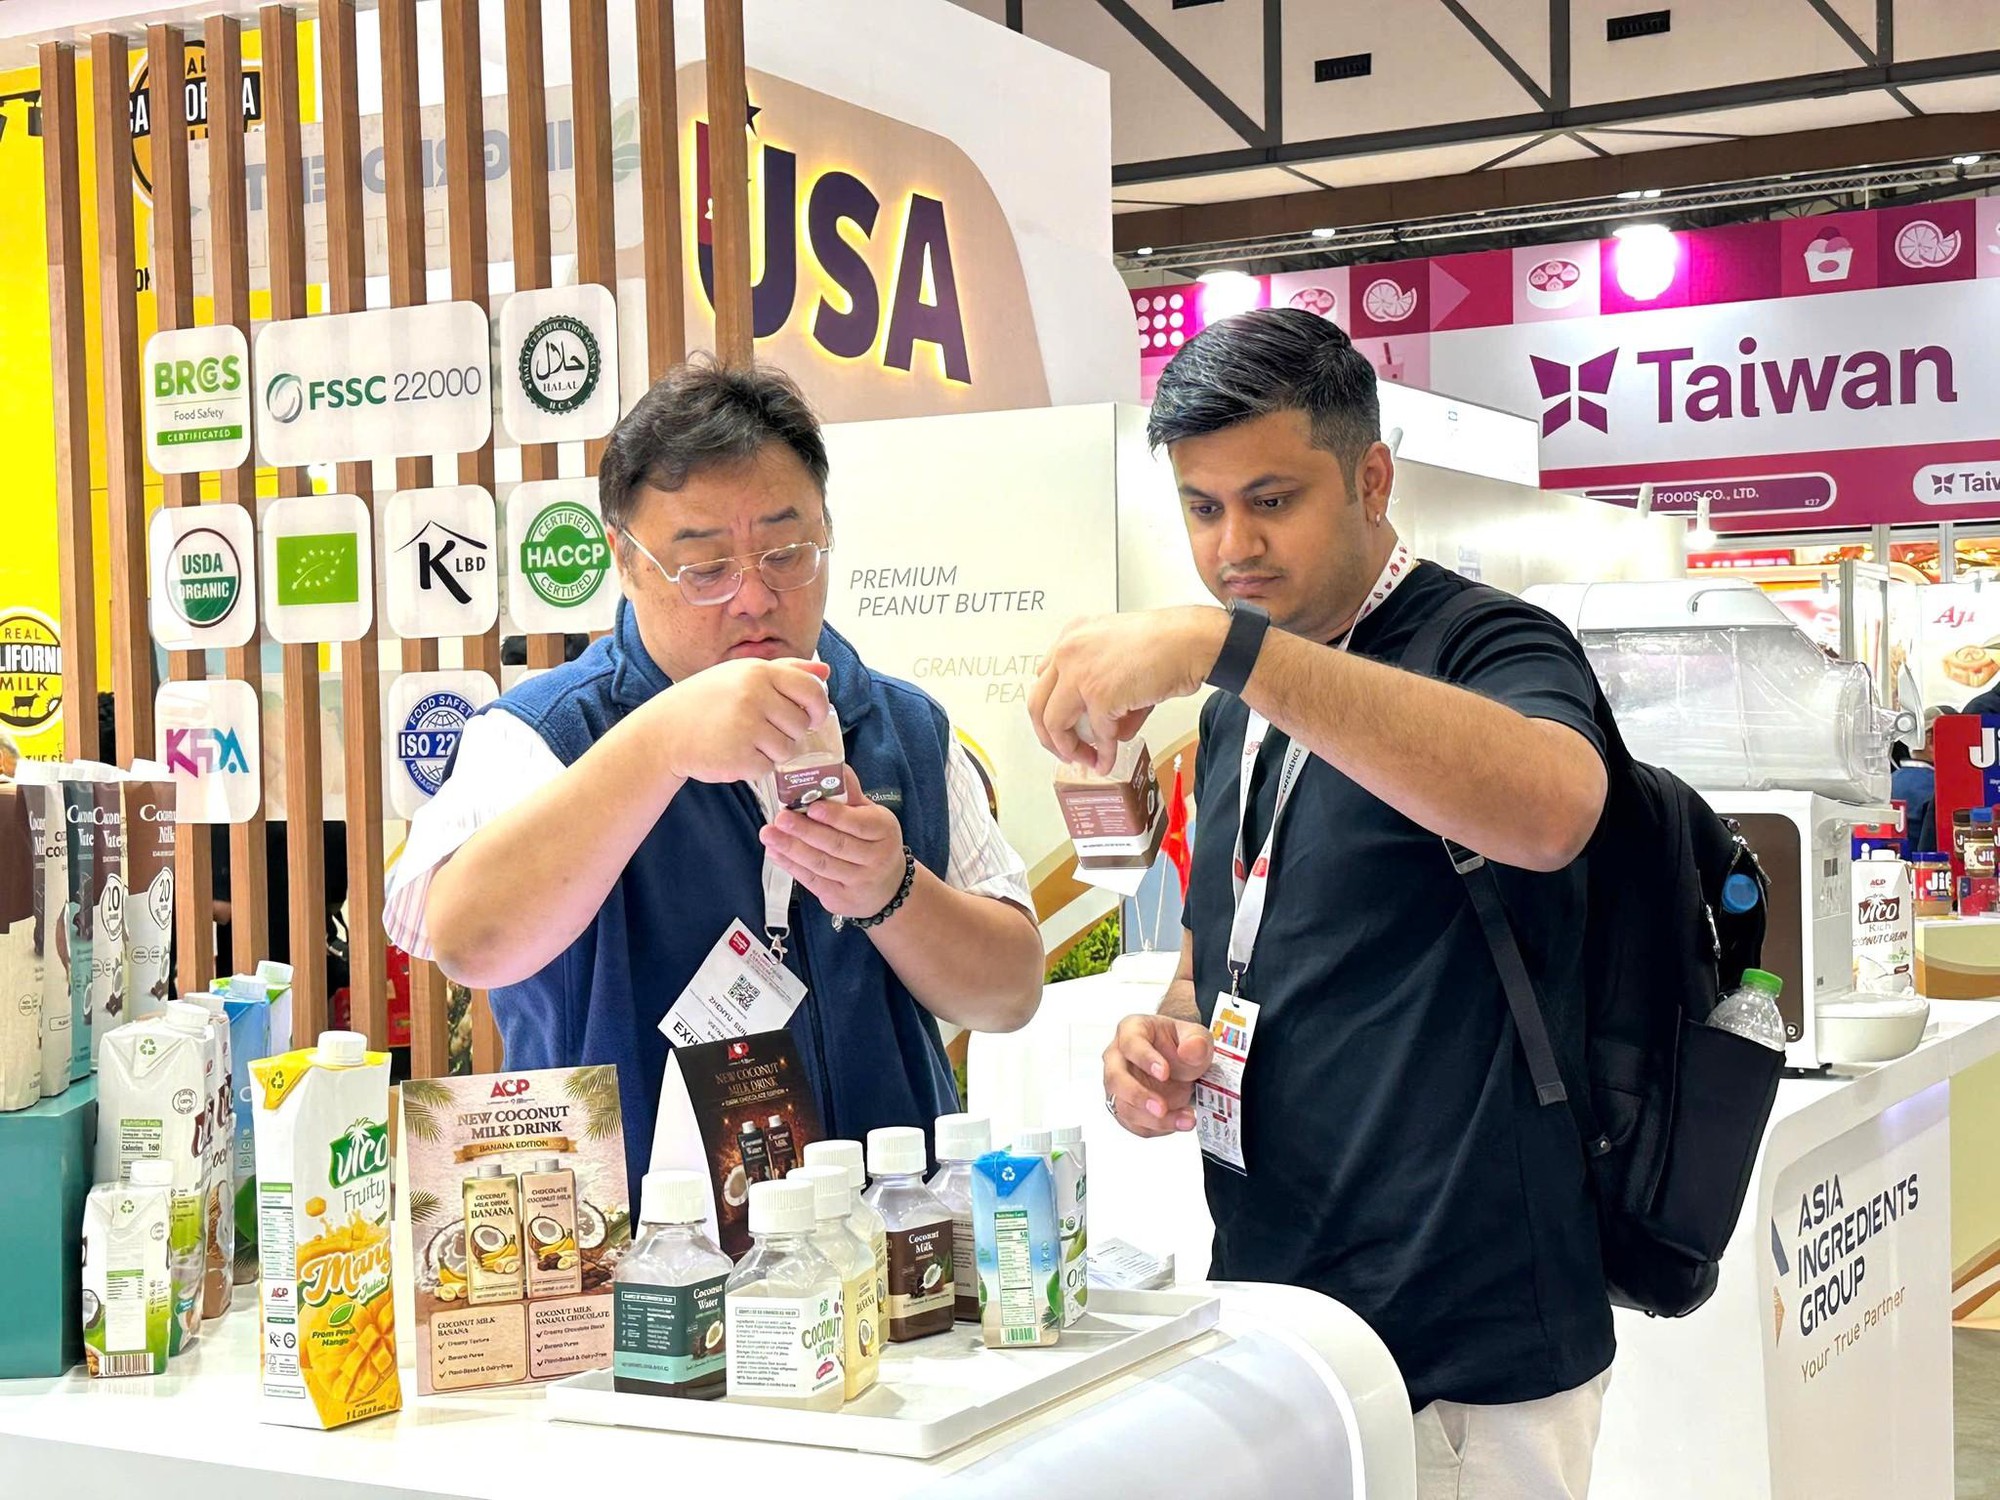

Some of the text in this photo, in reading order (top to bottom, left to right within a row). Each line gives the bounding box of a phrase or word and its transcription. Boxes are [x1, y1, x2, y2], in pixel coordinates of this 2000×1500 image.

[695, 121, 972, 385] USA
[309, 366, 481, 410] FSSC 22000
[543, 381, 579, 392] HALAL
[1637, 336, 1957, 423] Taiwan
[174, 407, 224, 421] Food Safety
[167, 428, 231, 443] CERTIFICATED
[1657, 492, 1700, 504] FOODS
[1734, 488, 1759, 499] LTD.
[539, 512, 591, 538] CERTIFIED
[181, 553, 224, 574] USDA
[455, 556, 486, 573] LBD
[526, 543, 605, 569] HACCP
[540, 573, 592, 597] CERTIFIED
[850, 565, 957, 589] PREMIUM
[177, 582, 230, 600] ORGANIC
[858, 590, 1045, 617] PEANUT BUTTER
[5, 628, 42, 640] REAL
[0, 677, 48, 691] MILK
[410, 697, 436, 725] FOOD
[166, 726, 249, 778] KFDA
[400, 733, 431, 757] ISO
[736, 1062, 779, 1080] COCONUT
[490, 1078, 530, 1098] ACP
[457, 1105, 570, 1127] NEW COCONUT
[471, 1121, 562, 1140] MILK DRINK
[479, 1140, 549, 1152] BANANA EDITION
[344, 1178, 386, 1213] Fruity
[475, 1192, 507, 1200] COCONUT
[531, 1187, 568, 1195] CHOCOLATE
[471, 1207, 514, 1219] BANANA
[1798, 1174, 1843, 1237] ASIA
[908, 1229, 939, 1244] Coconut
[1798, 1174, 1919, 1289] INGREDIENTS
[915, 1241, 934, 1254] Milk
[693, 1283, 723, 1300] Coconut
[1800, 1255, 1866, 1337] GROUP
[536, 1308, 571, 1318] COCONUT
[697, 1298, 719, 1310] Water
[437, 1319, 474, 1329] COCONUT
[536, 1311, 610, 1326] BANANA CHOCOLATE
[312, 1331, 335, 1339] From
[437, 1328, 469, 1337] BANANA
[1801, 1286, 1906, 1384] Your True Partner
